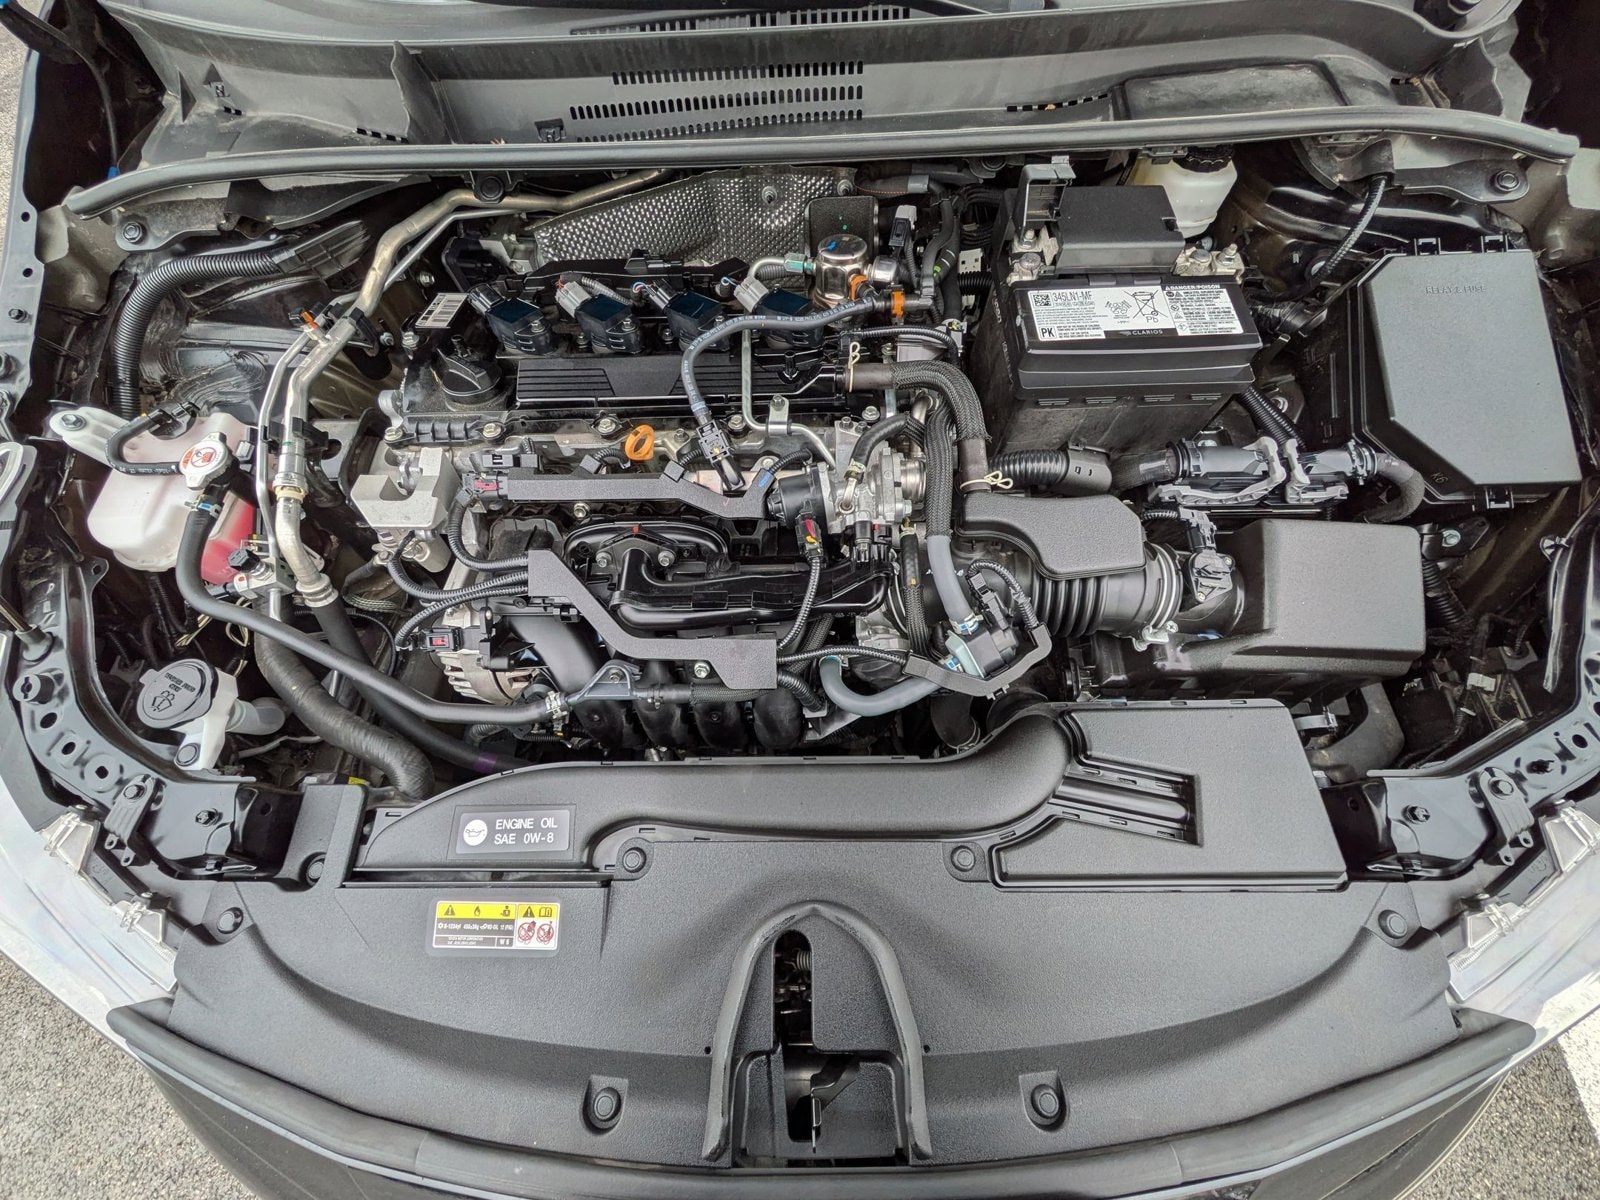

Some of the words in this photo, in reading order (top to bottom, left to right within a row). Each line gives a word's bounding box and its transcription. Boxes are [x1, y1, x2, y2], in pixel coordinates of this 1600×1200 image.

[1145, 315, 1159, 323] Pb
[1041, 327, 1055, 338] PK
[495, 818, 534, 830] ENGINE
[541, 817, 558, 829] OIL
[494, 833, 516, 845] SAE
[523, 832, 554, 844] 0W-8
